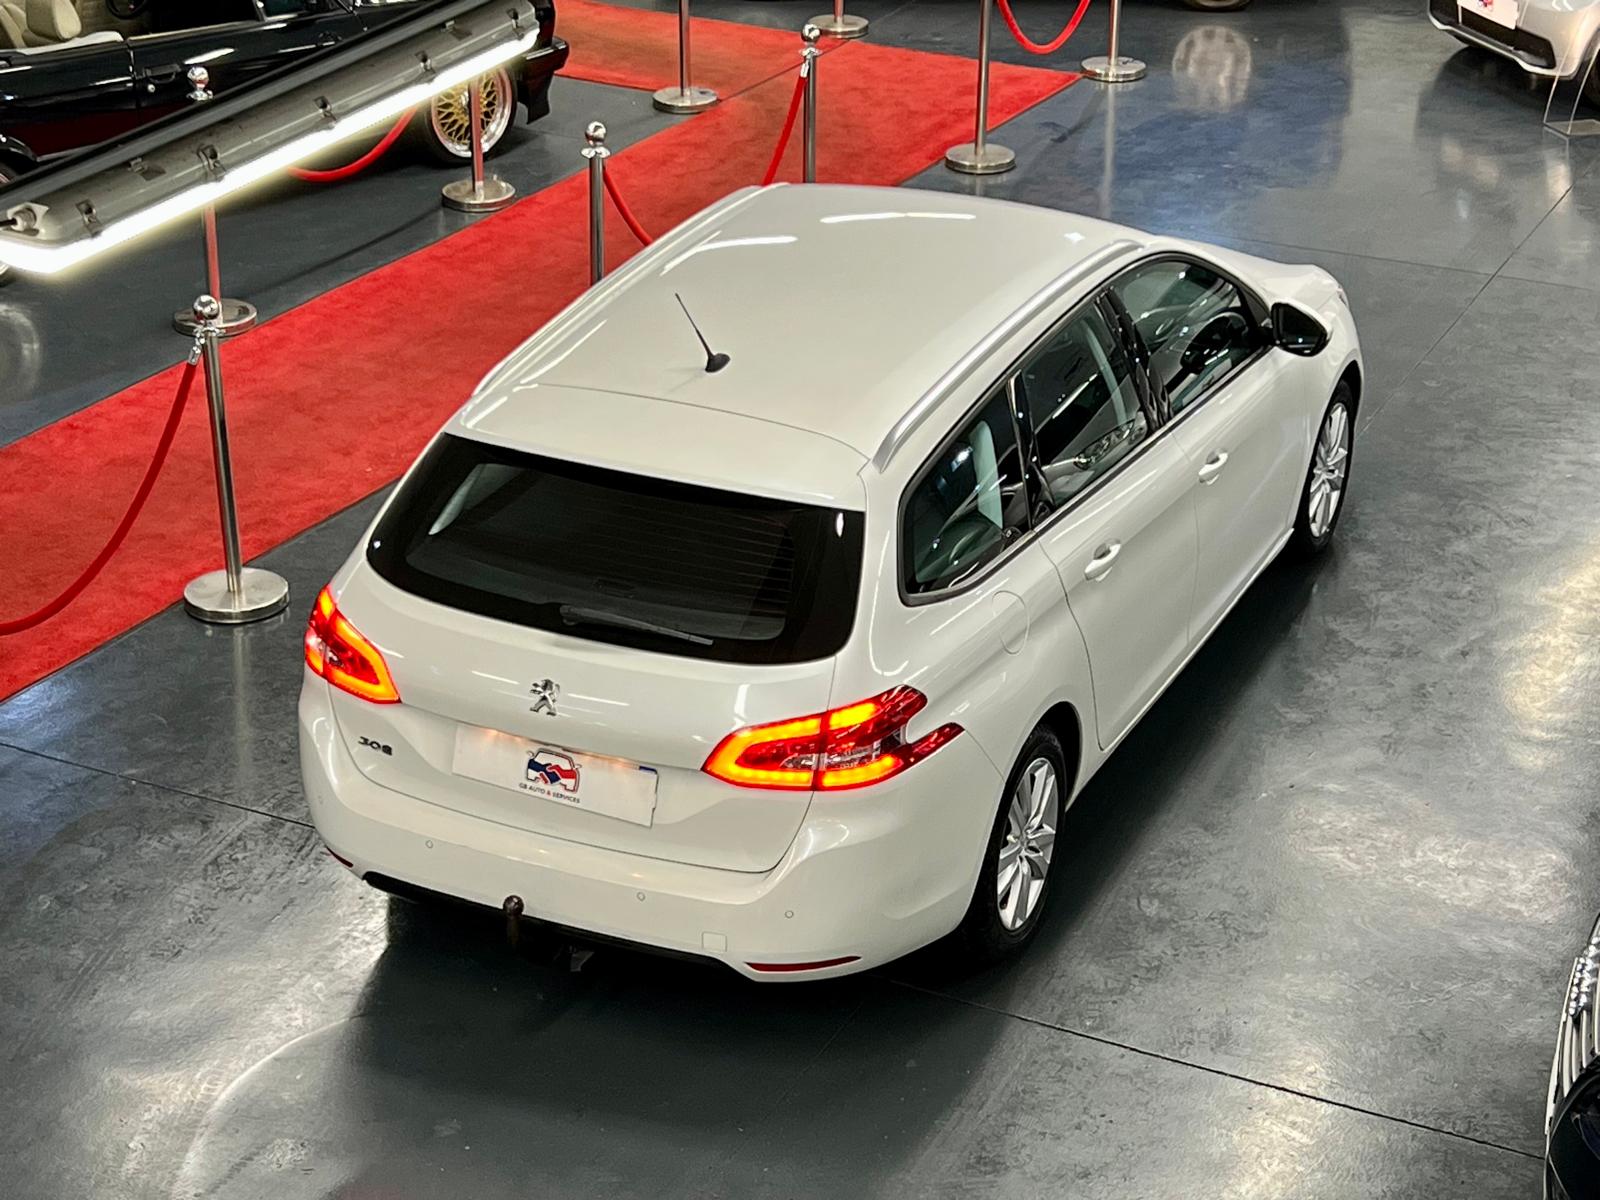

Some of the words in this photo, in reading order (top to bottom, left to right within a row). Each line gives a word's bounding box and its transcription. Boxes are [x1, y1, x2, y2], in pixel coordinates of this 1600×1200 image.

[518, 782, 528, 790] GB
[528, 785, 546, 794] AUTO
[552, 792, 581, 804] SERVICES
